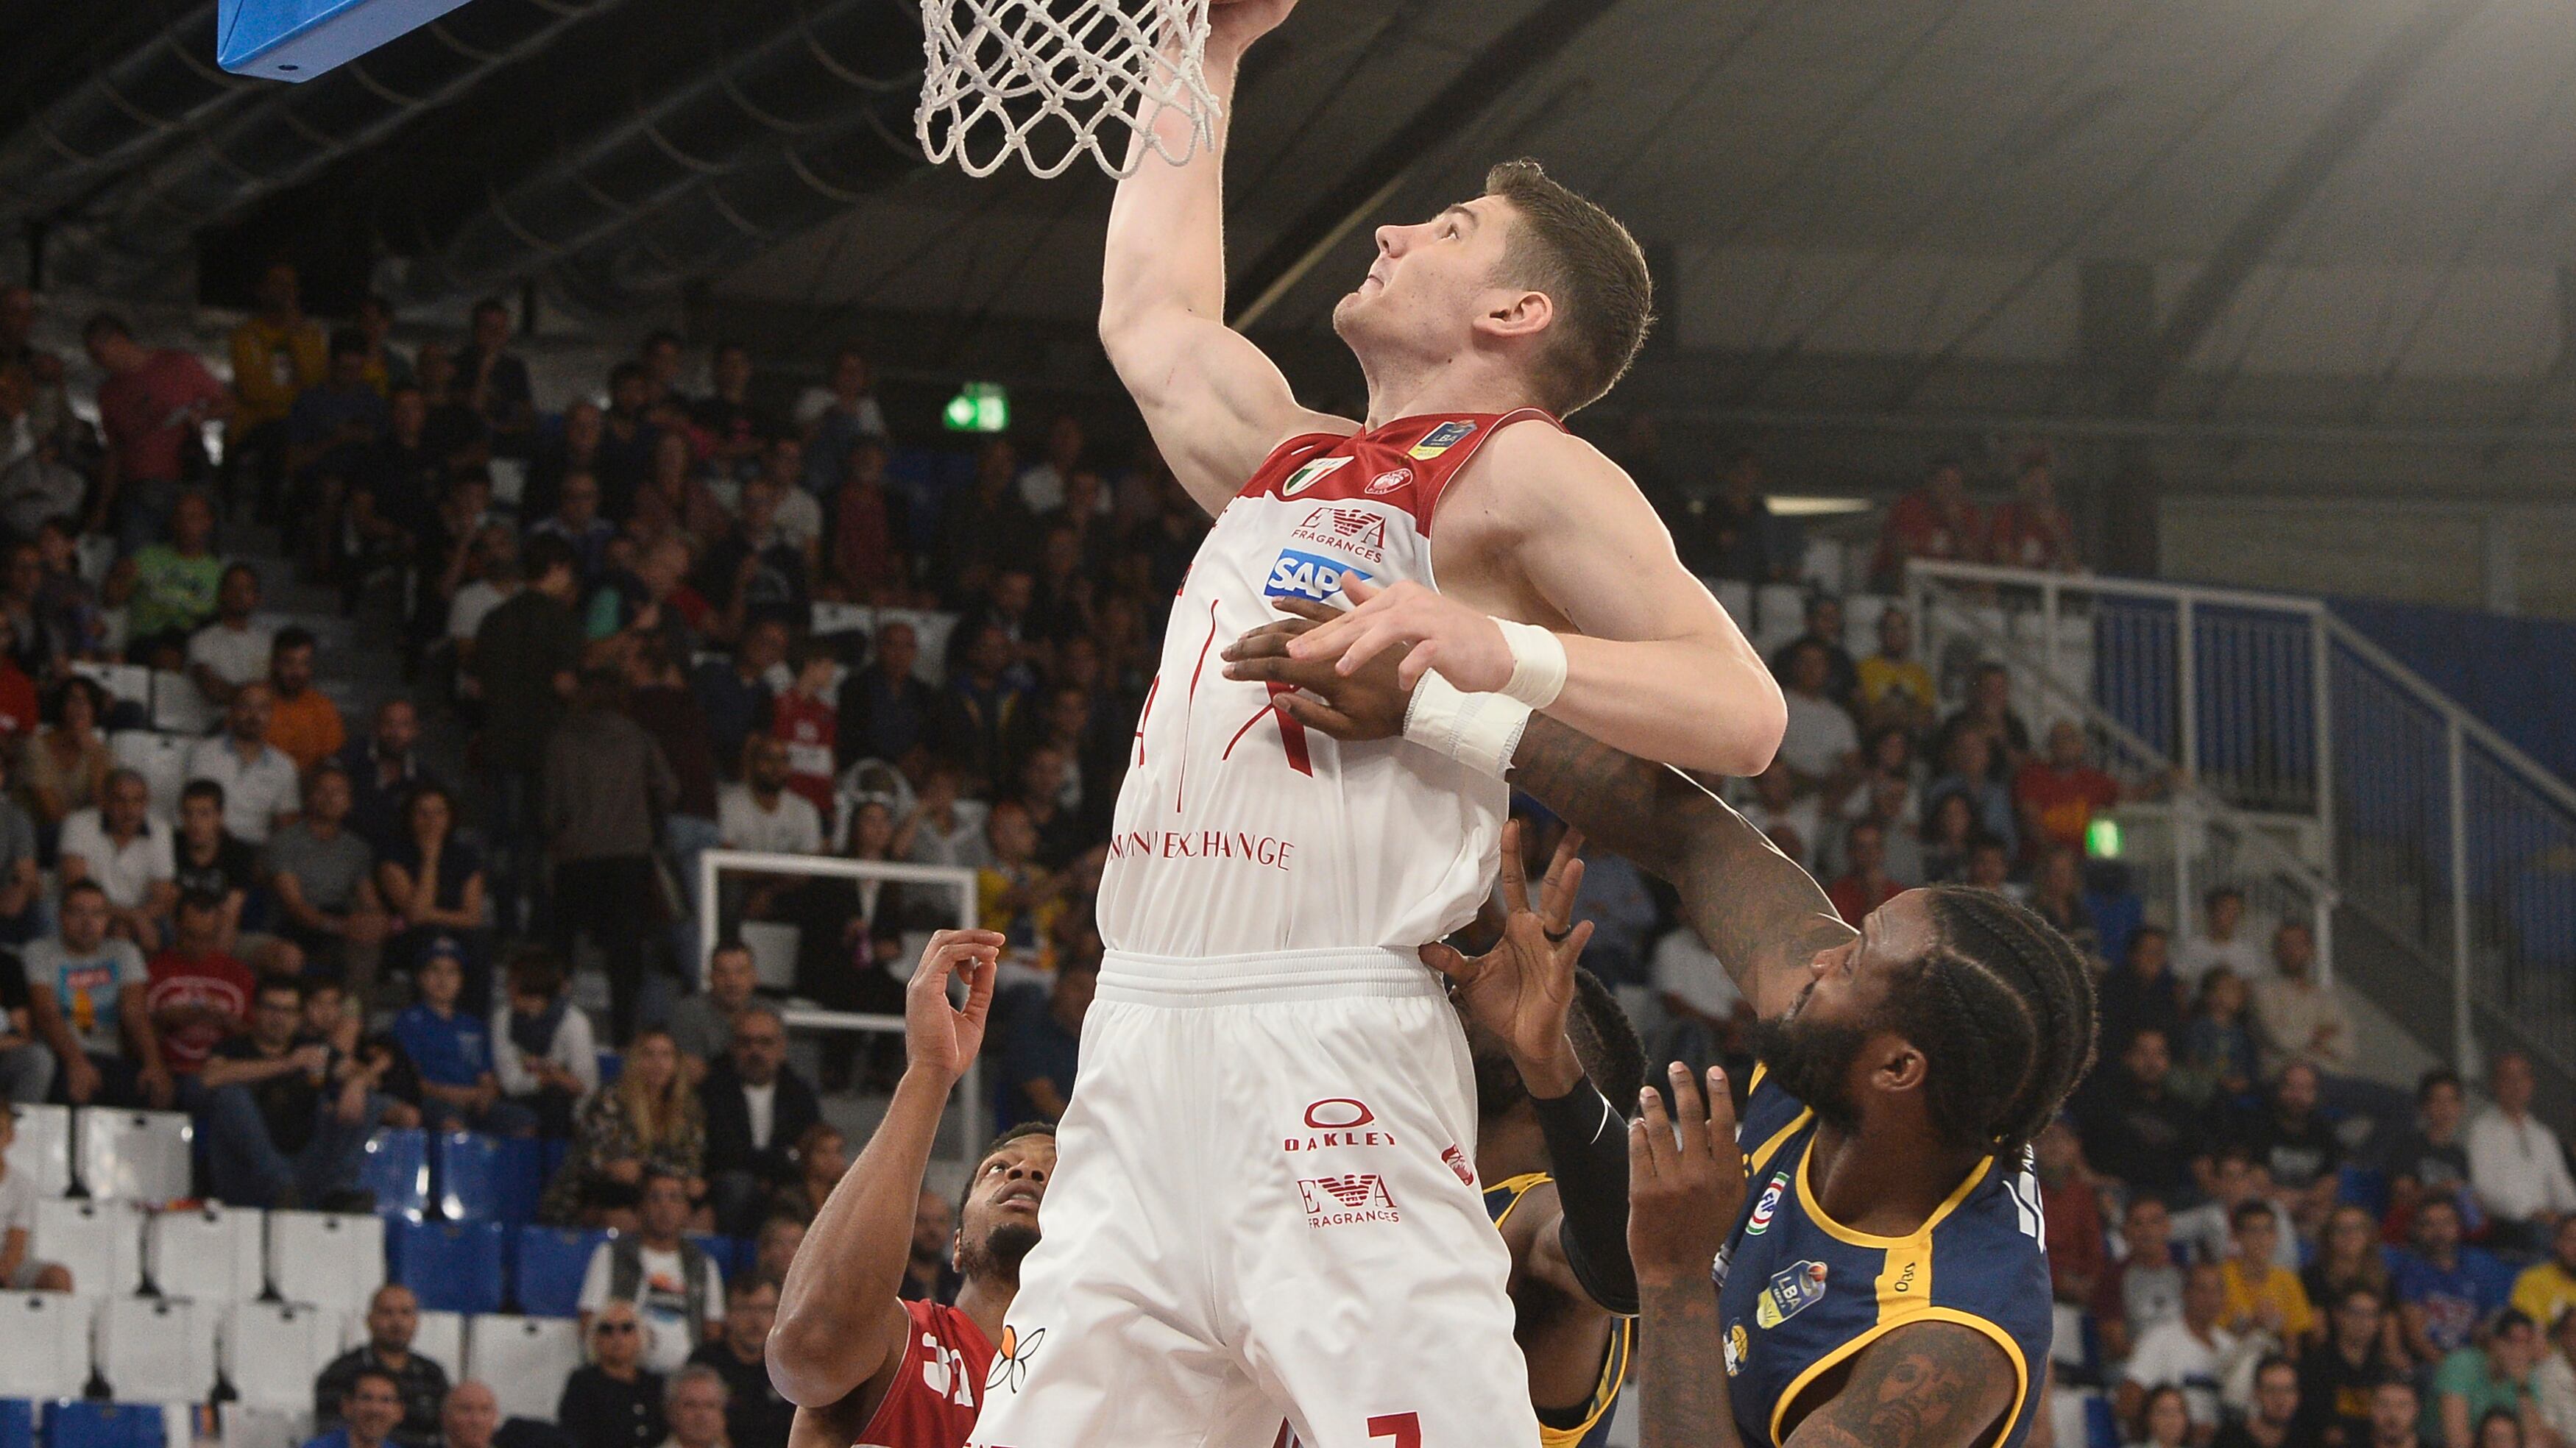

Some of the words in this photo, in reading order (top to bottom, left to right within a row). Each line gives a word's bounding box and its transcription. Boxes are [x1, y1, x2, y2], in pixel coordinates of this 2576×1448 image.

[1291, 529, 1382, 564] FRAGRANCES
[1268, 557, 1342, 599] SAP
[1284, 1132, 1396, 1151] OAKLEY
[1761, 1191, 1778, 1213] FIP
[1308, 1210, 1399, 1229] FRAGRANCES
[1777, 1276, 1802, 1310] LBA
